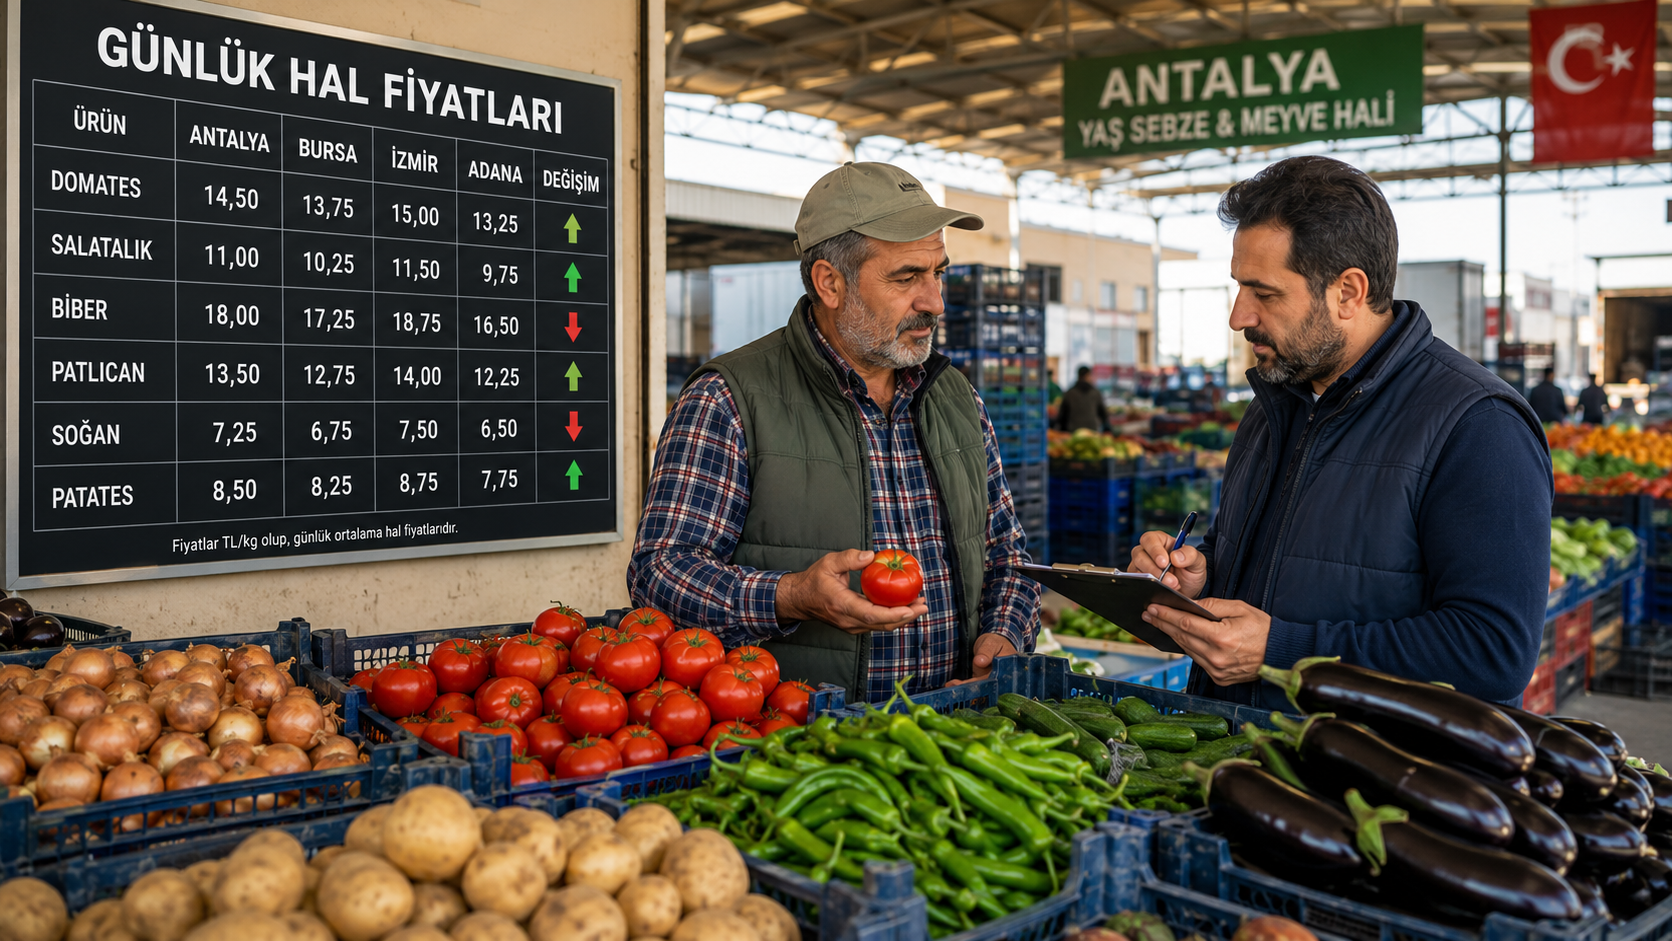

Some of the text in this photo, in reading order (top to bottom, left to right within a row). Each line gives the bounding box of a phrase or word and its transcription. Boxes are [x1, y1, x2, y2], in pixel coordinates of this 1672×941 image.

[97, 22, 562, 135] GÜNLÜK HAL FİYATLARI
[1098, 47, 1340, 110] ANTALYA
[74, 105, 125, 135] ÜRÜN
[1078, 89, 1396, 152] YAŞ SEBZE & MEYVE HALİ
[190, 125, 270, 152] ANTALYA
[299, 138, 357, 163] BURSA
[392, 146, 438, 173] İZMİR
[52, 170, 141, 198] DOMATES
[468, 161, 523, 183] ADANA
[544, 168, 599, 195] DEĞİŞİM
[205, 185, 258, 211] 14,50
[303, 195, 353, 219] 13,75
[392, 204, 439, 227] 15,00
[474, 212, 517, 234] 13,25
[52, 234, 152, 260] SALATALIK
[205, 245, 258, 270] 11,00
[304, 252, 354, 276] 10,25
[393, 258, 439, 281] 11,50
[483, 264, 518, 286] 9,75
[52, 293, 107, 320] BİBER
[205, 304, 259, 329] 18,00
[304, 308, 354, 332] 17,25
[393, 312, 440, 335] 18,75
[474, 316, 518, 337] 16,50
[52, 361, 144, 382] PATLICAN
[206, 363, 259, 387] 13,50
[304, 365, 355, 388] 12,75
[394, 366, 441, 388] 14,00
[475, 368, 519, 389] 12,25
[52, 420, 119, 445] SOĞAN
[213, 422, 256, 446] 7,25
[312, 421, 351, 444] 6,75
[400, 420, 437, 442] 7,50
[482, 419, 517, 441] 6,50
[213, 479, 256, 504] 8,50
[312, 476, 352, 499] 8,25
[400, 472, 437, 495] 8,75
[482, 470, 517, 491] 7,75
[53, 485, 133, 508] PATATES
[173, 522, 458, 555] Fiyatlar TL/kg olup, günlük ortalama hal fiyatlarıdır.
